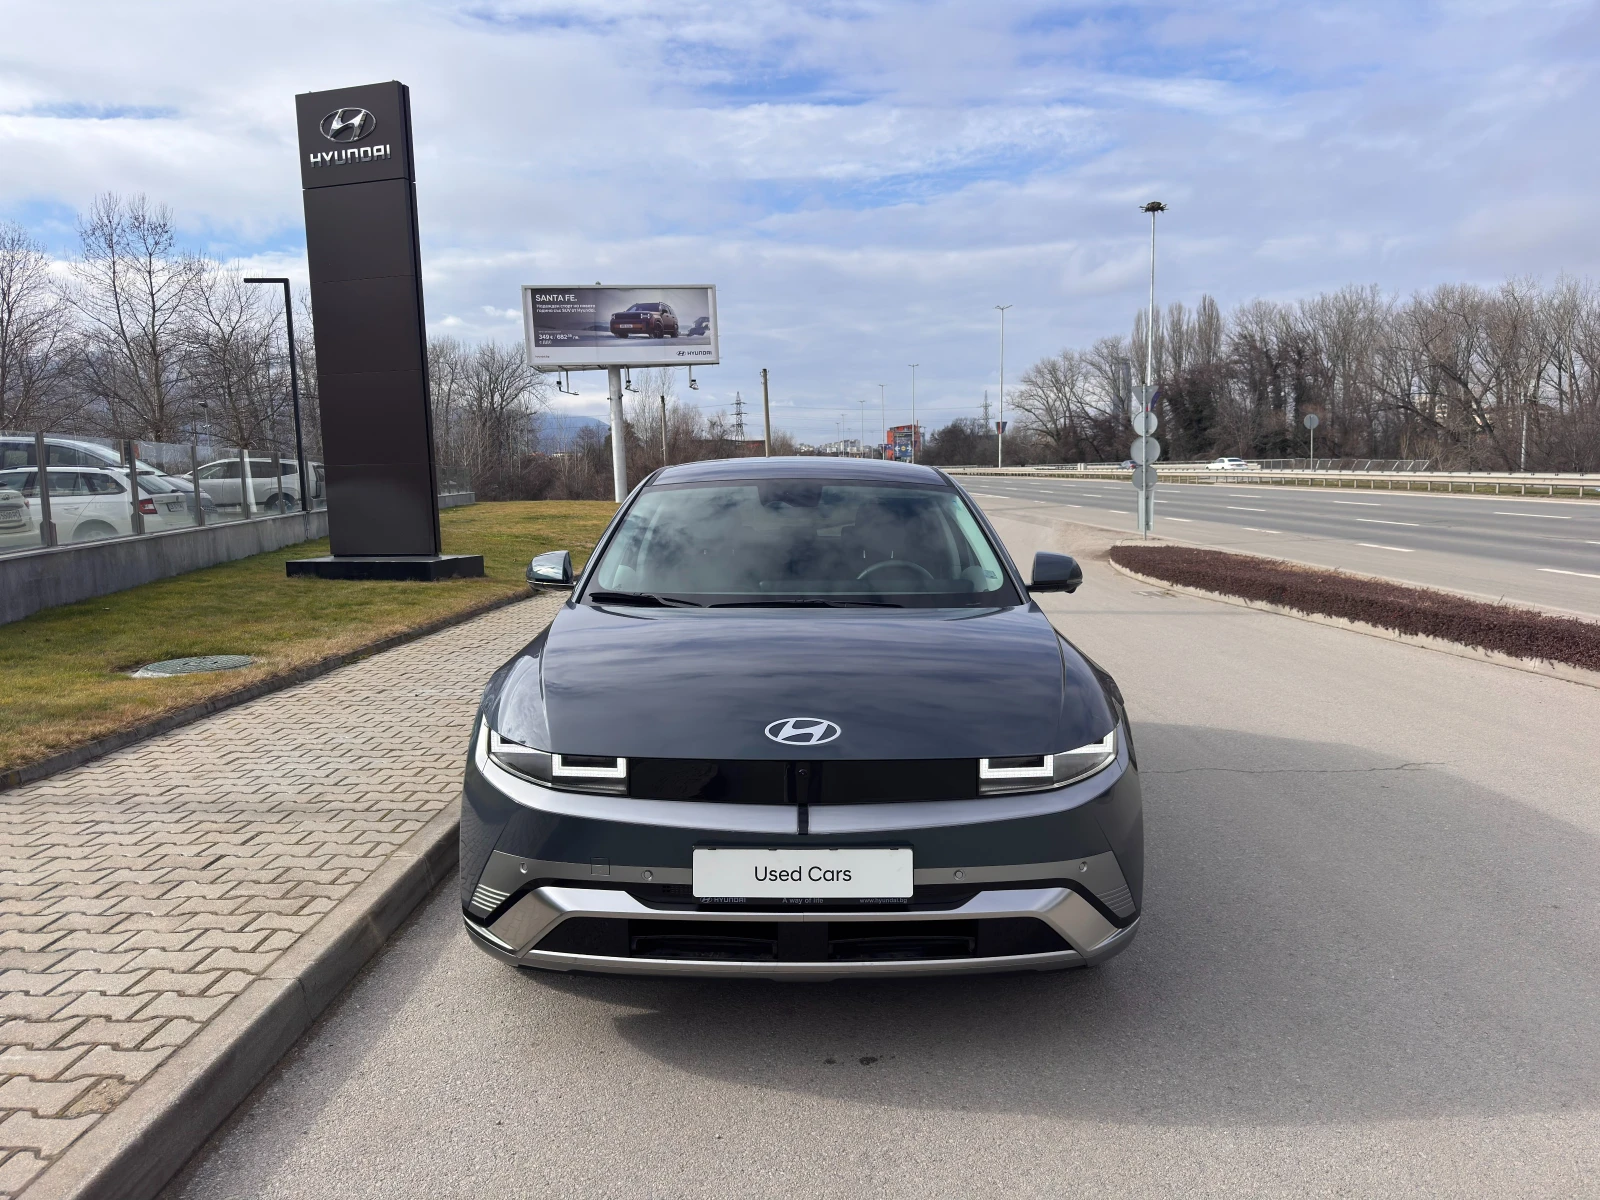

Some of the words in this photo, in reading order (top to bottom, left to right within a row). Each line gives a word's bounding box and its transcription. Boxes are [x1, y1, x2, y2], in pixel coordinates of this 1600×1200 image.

[310, 144, 390, 167] HYUNDAI
[754, 865, 802, 882] Used
[808, 866, 852, 882] Cars
